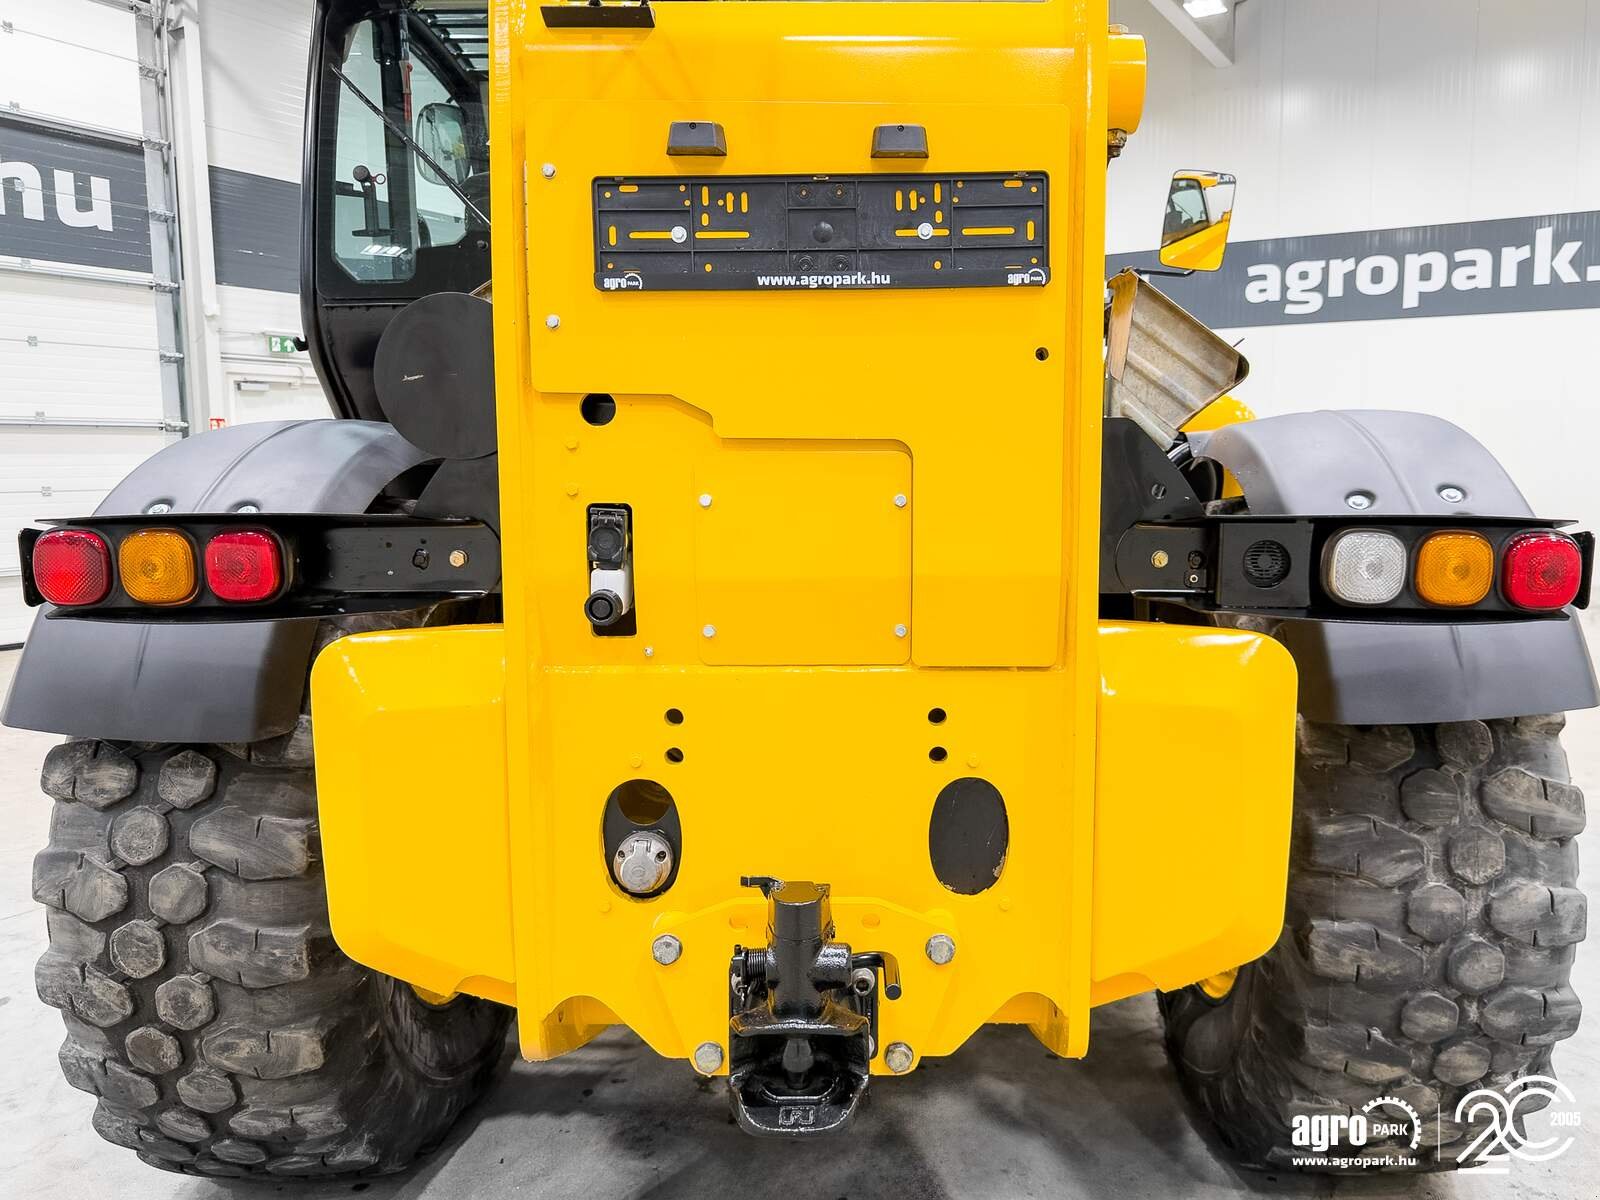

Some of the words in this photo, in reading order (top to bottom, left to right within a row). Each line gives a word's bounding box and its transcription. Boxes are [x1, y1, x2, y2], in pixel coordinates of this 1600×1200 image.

[1245, 227, 1600, 315] agropark.
[603, 278, 627, 290] agro
[757, 271, 891, 288] www.agropark.hu
[1007, 273, 1030, 285] agro
